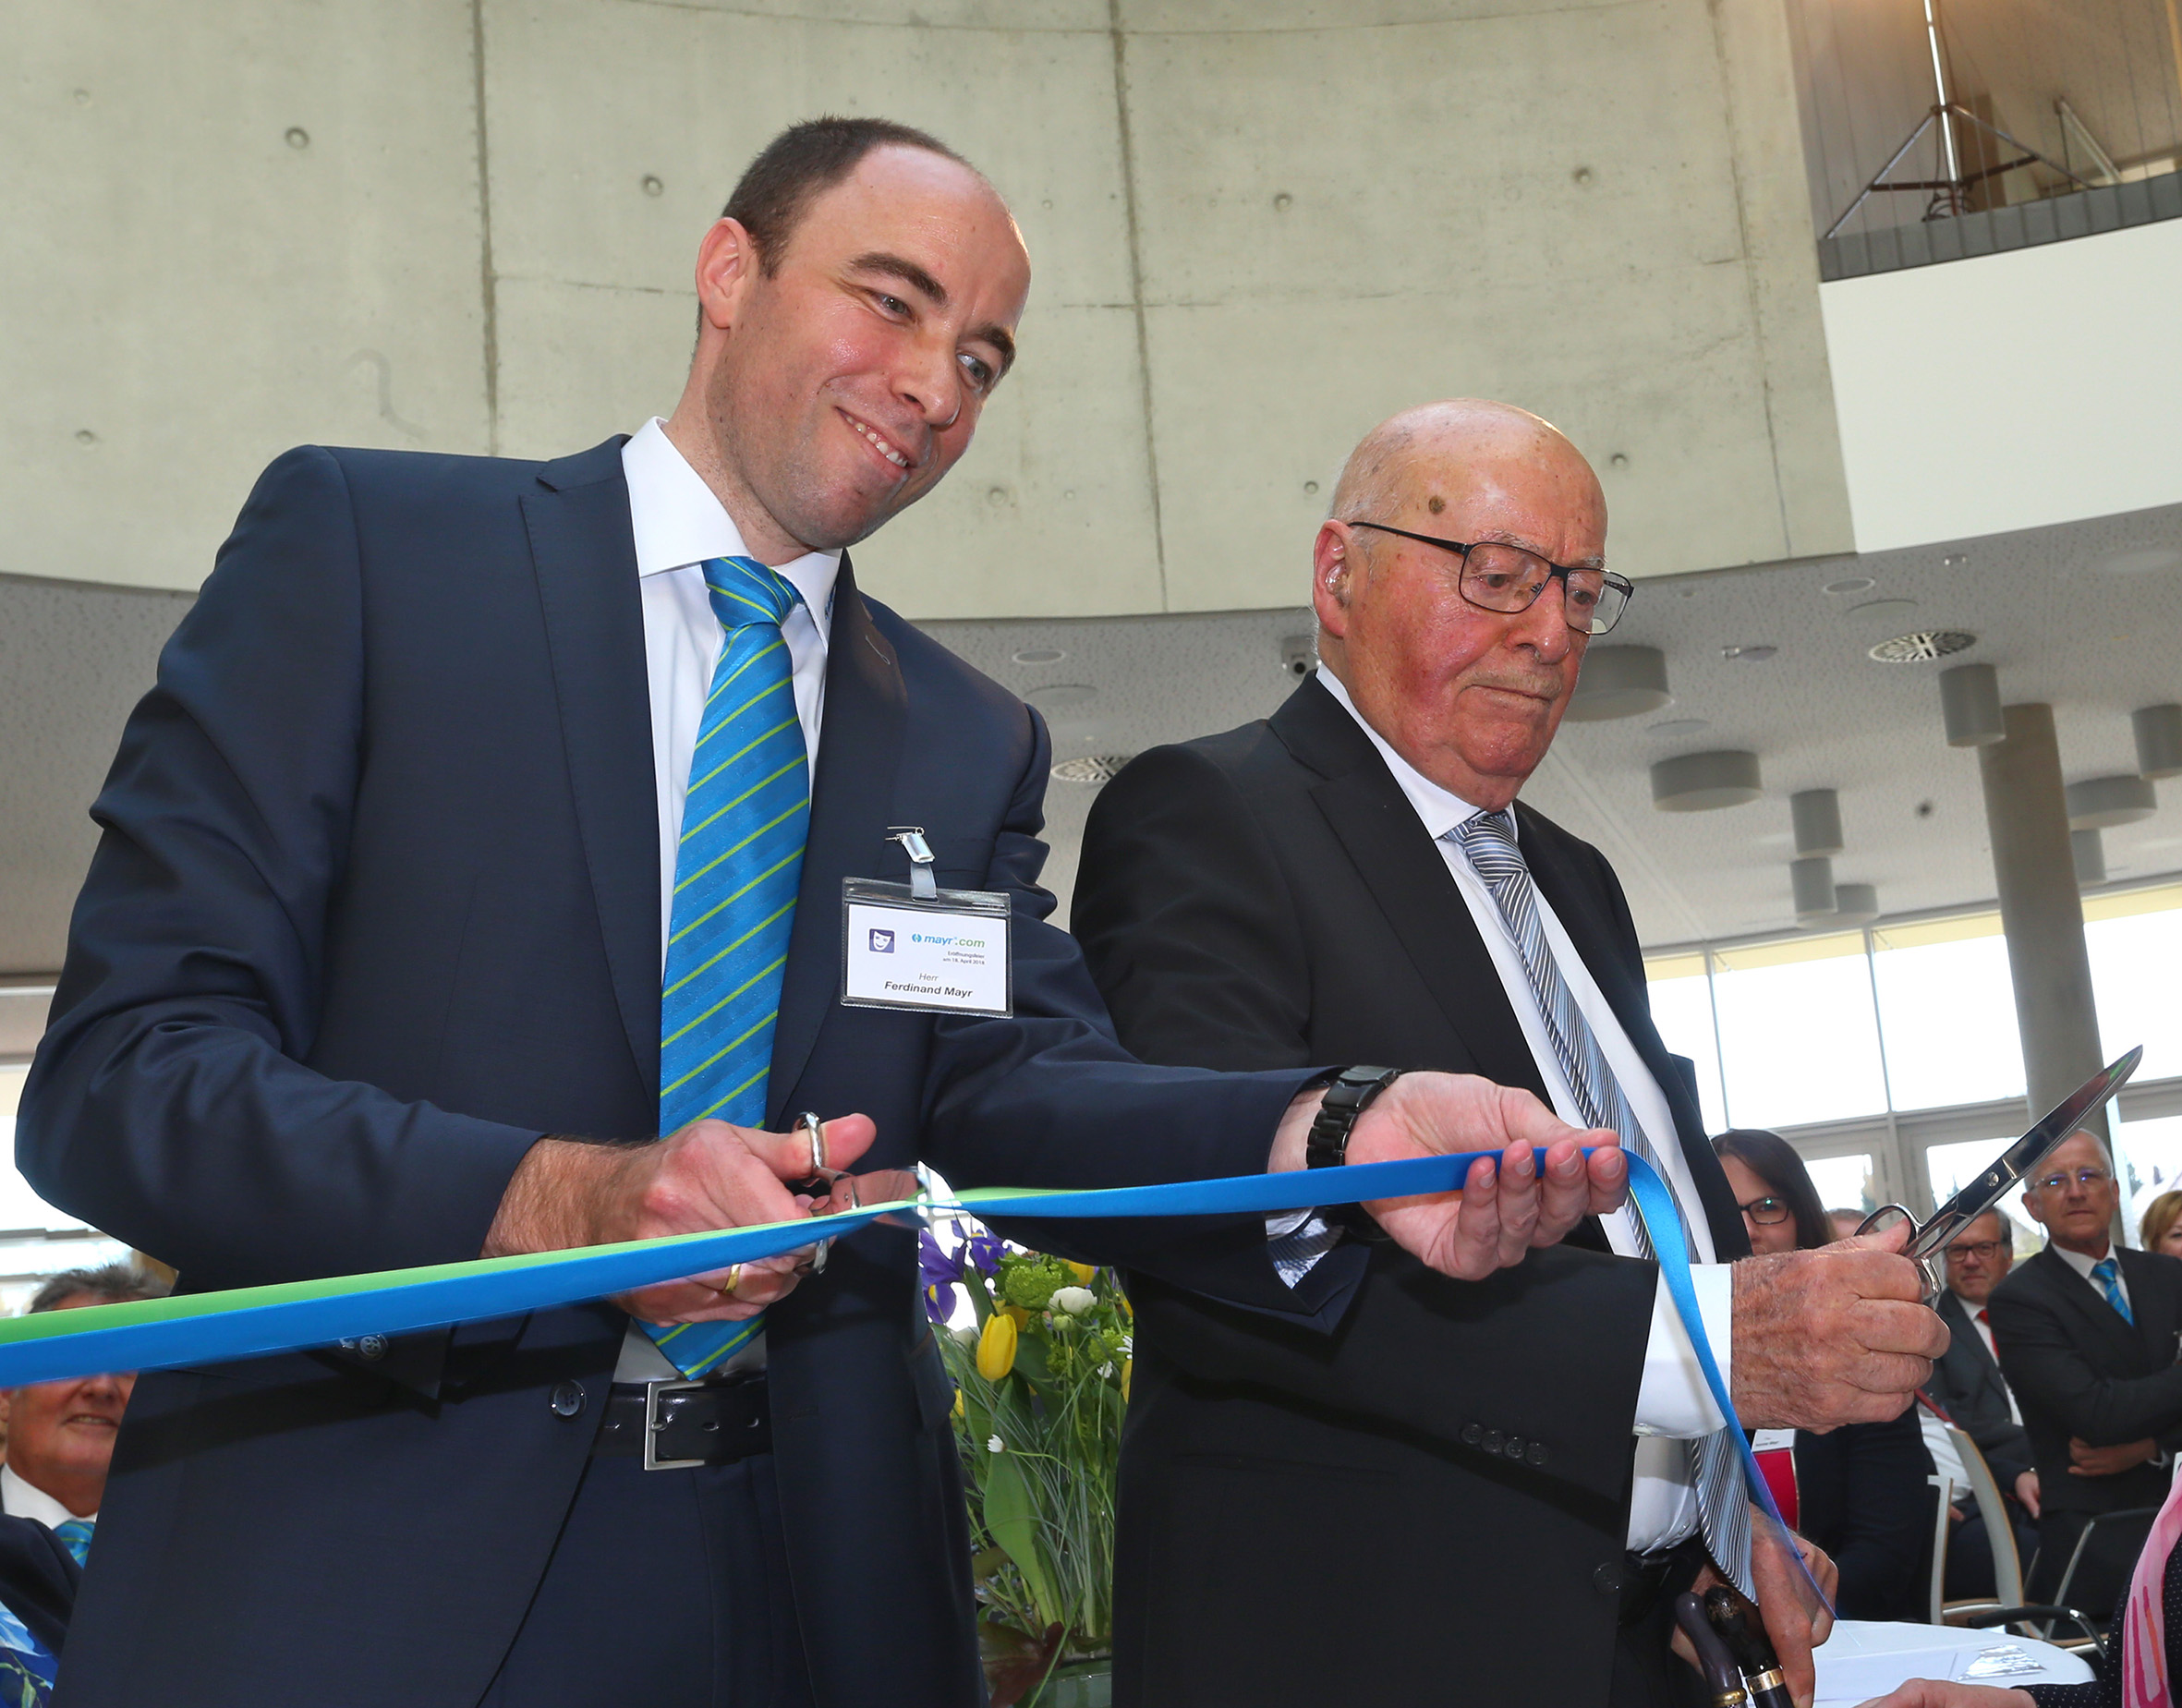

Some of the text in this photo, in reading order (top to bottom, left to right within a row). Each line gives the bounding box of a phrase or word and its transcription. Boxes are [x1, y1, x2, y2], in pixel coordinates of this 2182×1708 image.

[918, 973, 939, 981] Herr
[884, 981, 973, 999] Ferdinand Mayr
